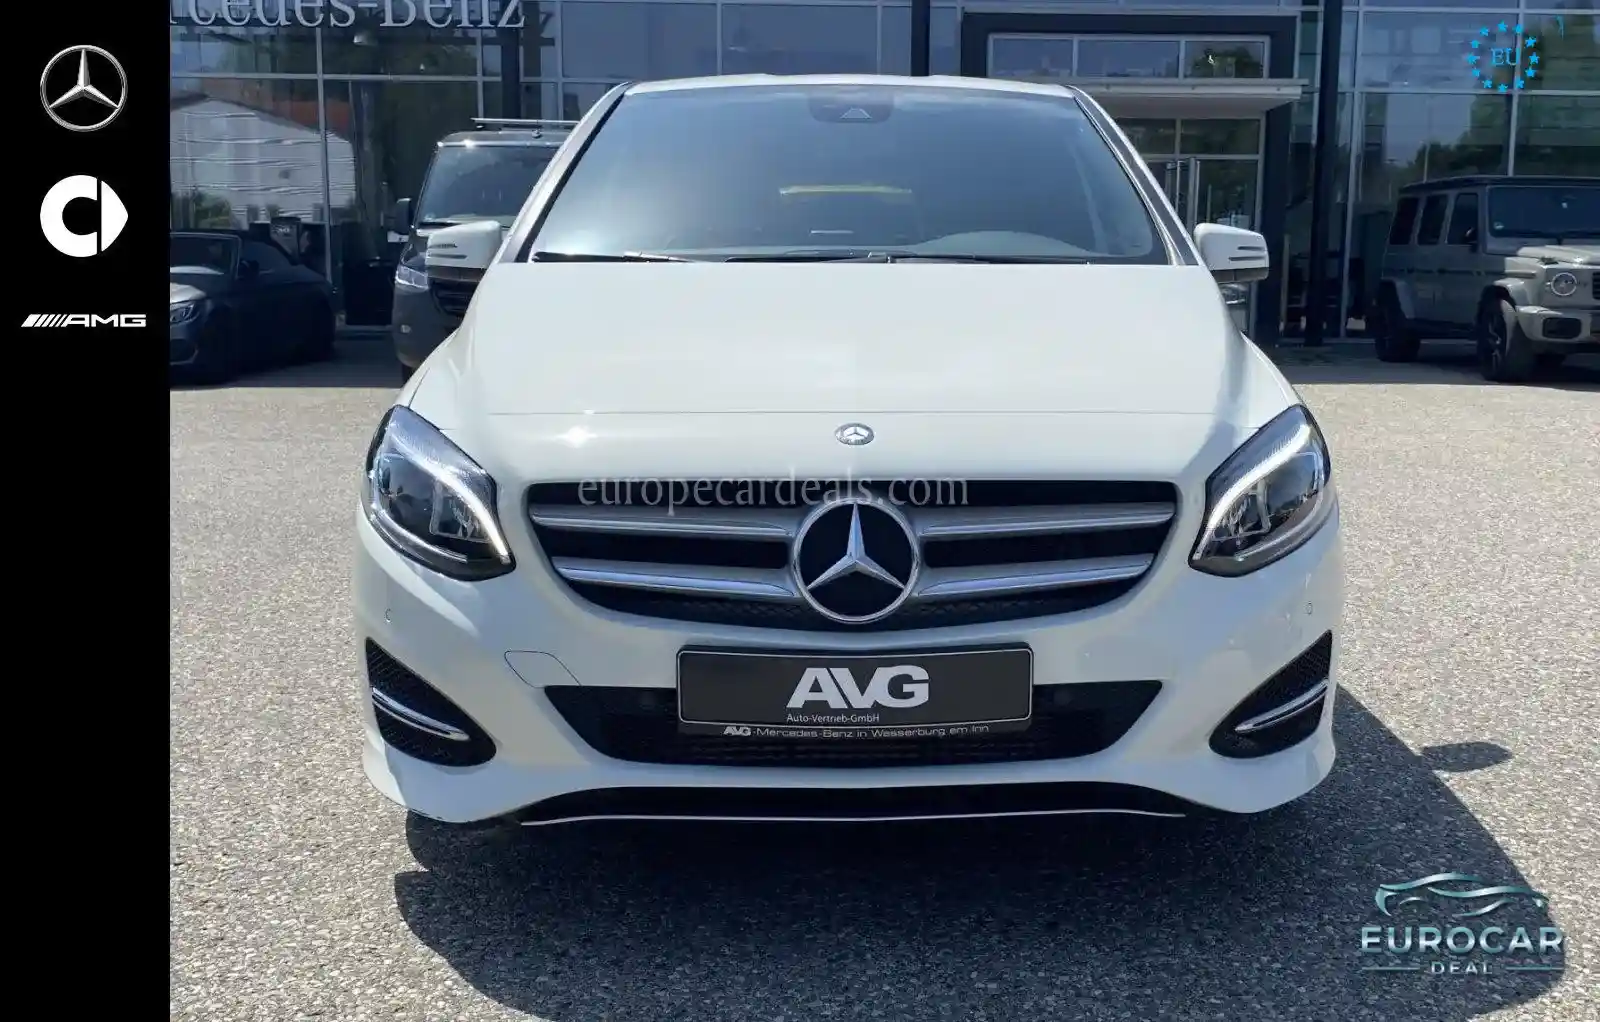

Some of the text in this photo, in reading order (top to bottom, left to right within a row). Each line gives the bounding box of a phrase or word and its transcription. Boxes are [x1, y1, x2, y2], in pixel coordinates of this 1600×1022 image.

[170, 0, 525, 28] cedes-Benz
[786, 665, 929, 709] AVG
[786, 712, 880, 724] Auto-Vertrieb-GmbH
[857, 729, 867, 738] in
[972, 724, 989, 733] Inn
